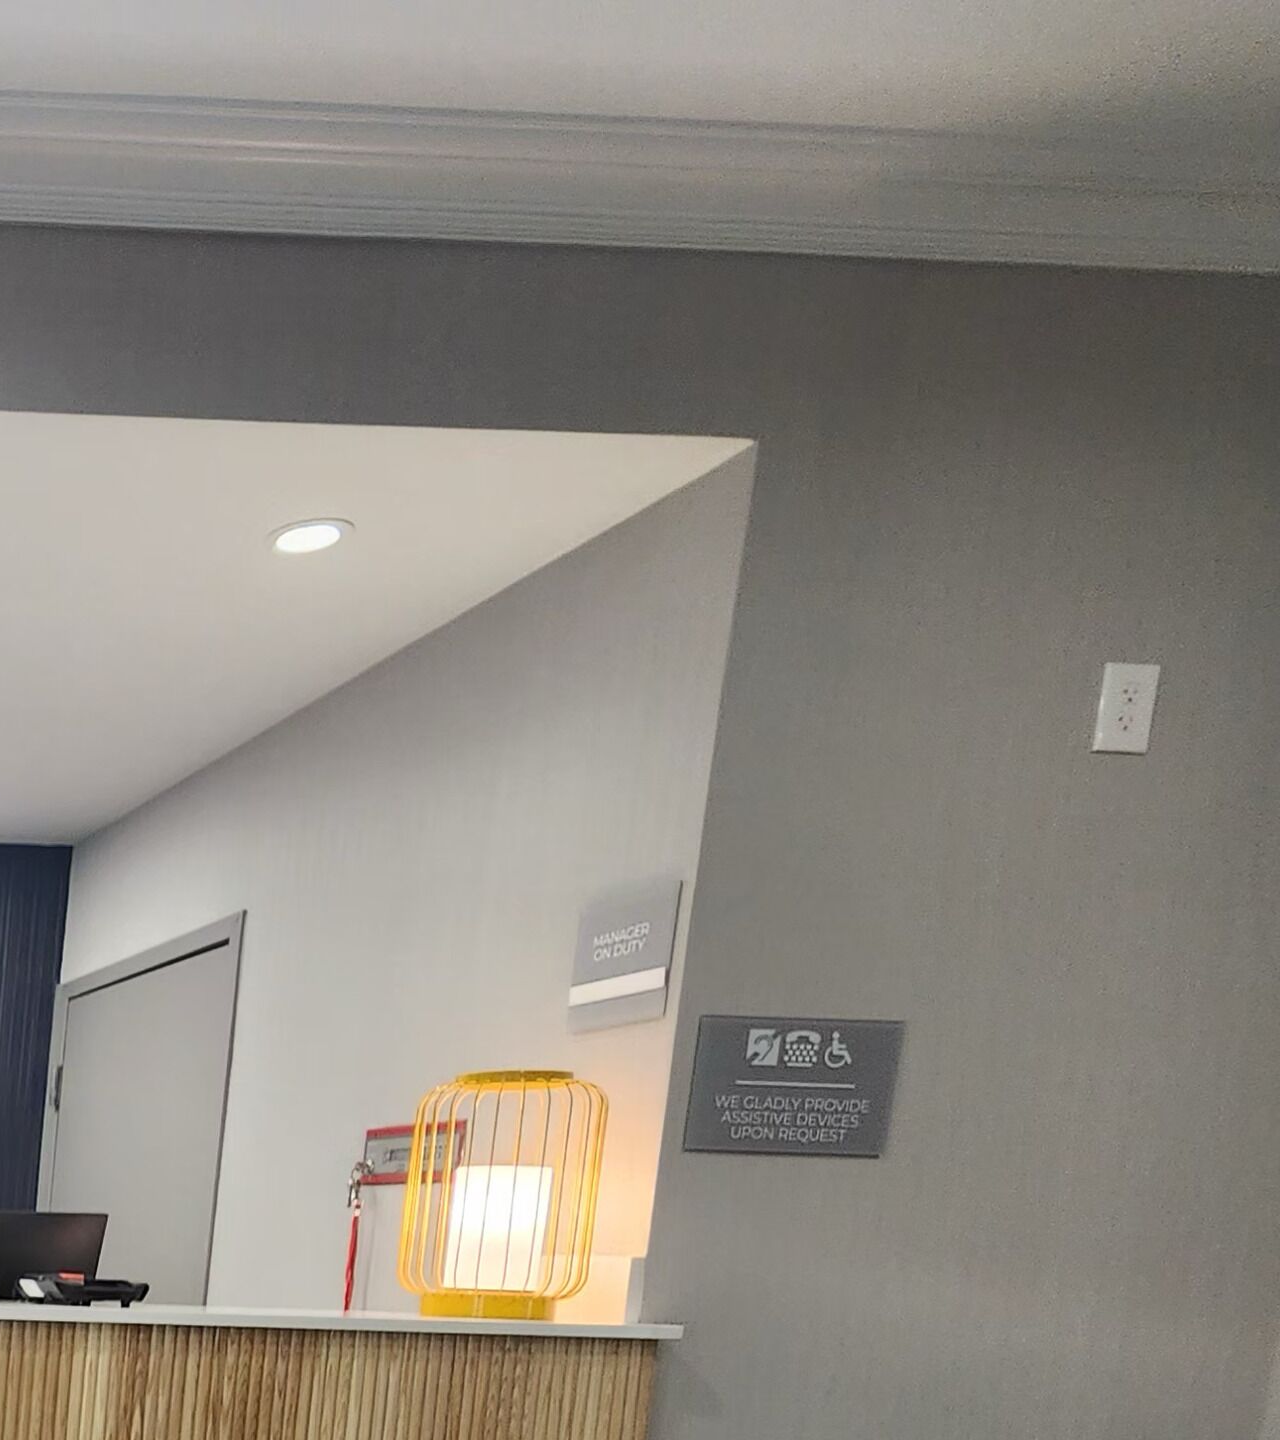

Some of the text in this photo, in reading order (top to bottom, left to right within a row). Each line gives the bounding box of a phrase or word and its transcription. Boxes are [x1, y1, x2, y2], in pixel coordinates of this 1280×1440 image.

[593, 921, 649, 947] MANAGER
[593, 937, 646, 961] ON DUTY
[715, 1095, 871, 1113] WE GLADLY PROVIDE
[721, 1110, 860, 1128] ASSISTIVE DEVICES
[730, 1126, 847, 1143] UPON REQUEST
